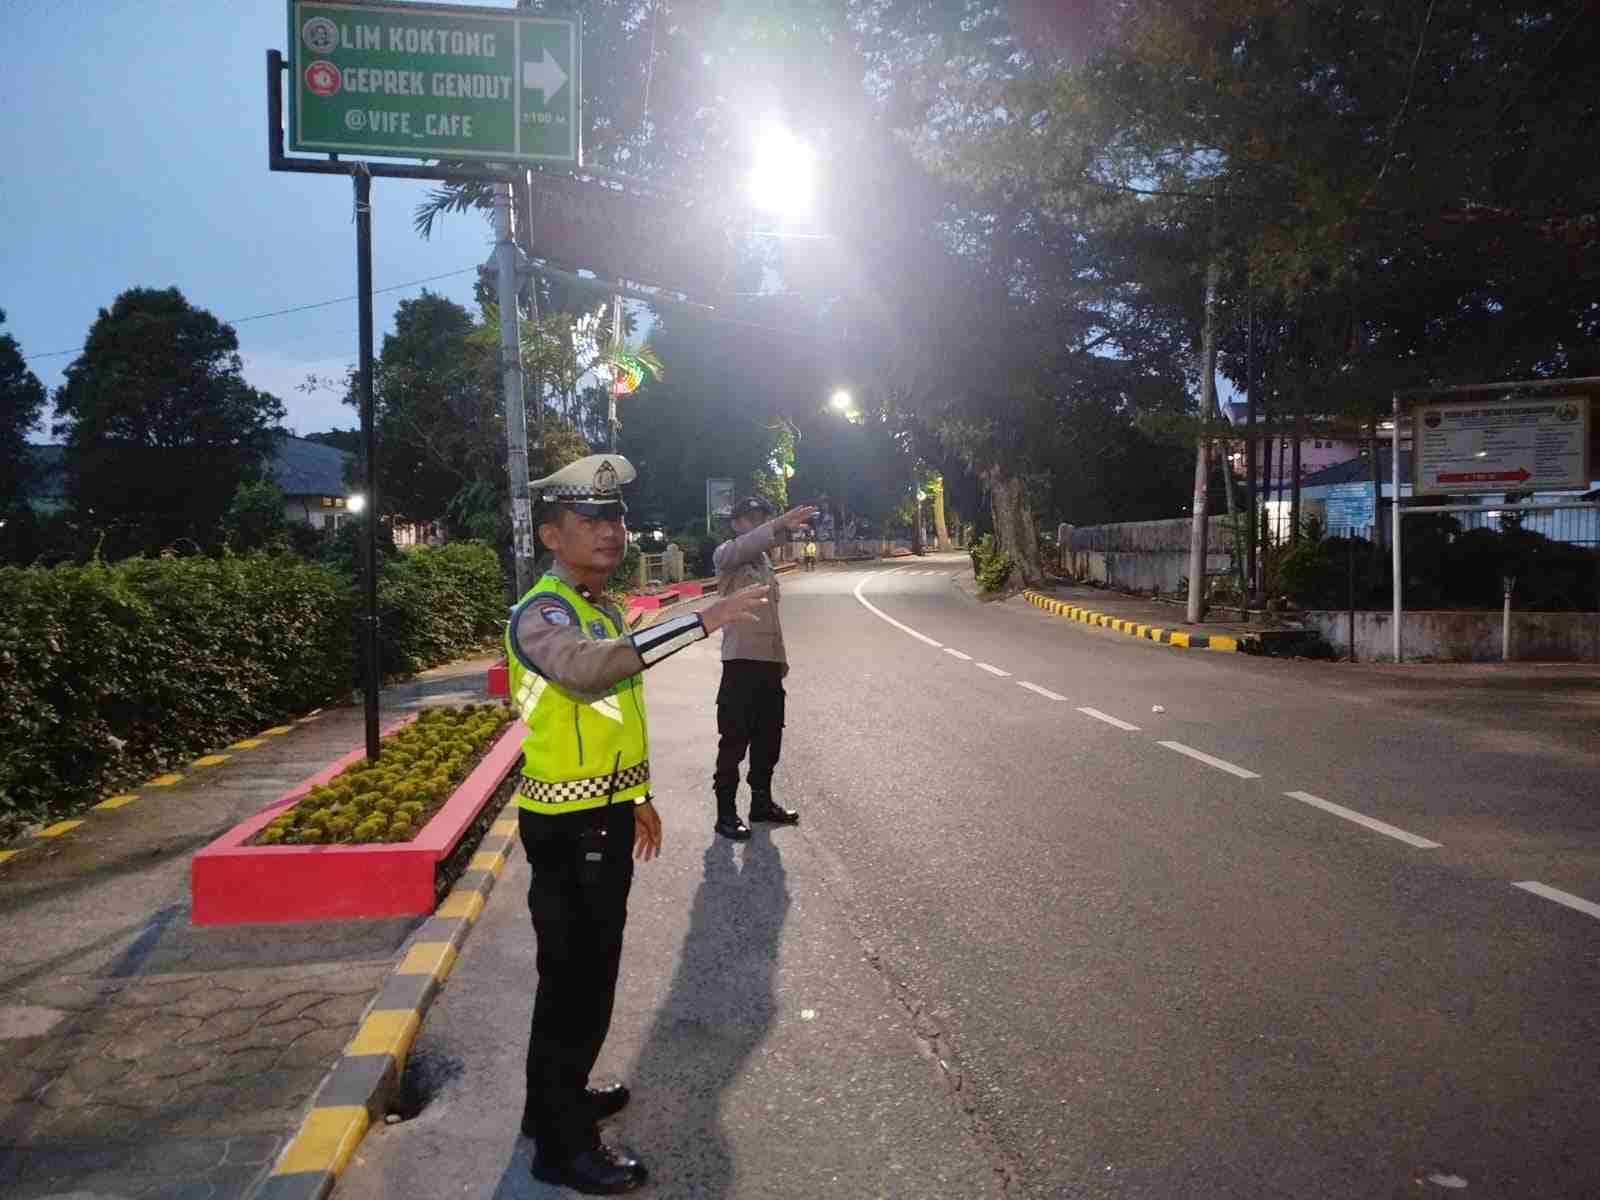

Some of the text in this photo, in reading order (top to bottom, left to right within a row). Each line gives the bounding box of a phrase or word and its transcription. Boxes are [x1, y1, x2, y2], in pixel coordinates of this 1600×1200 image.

[341, 24, 496, 57] LIM KOKTONG
[343, 67, 425, 96] GEPREK
[344, 109, 473, 138] @VIFE_CAFE
